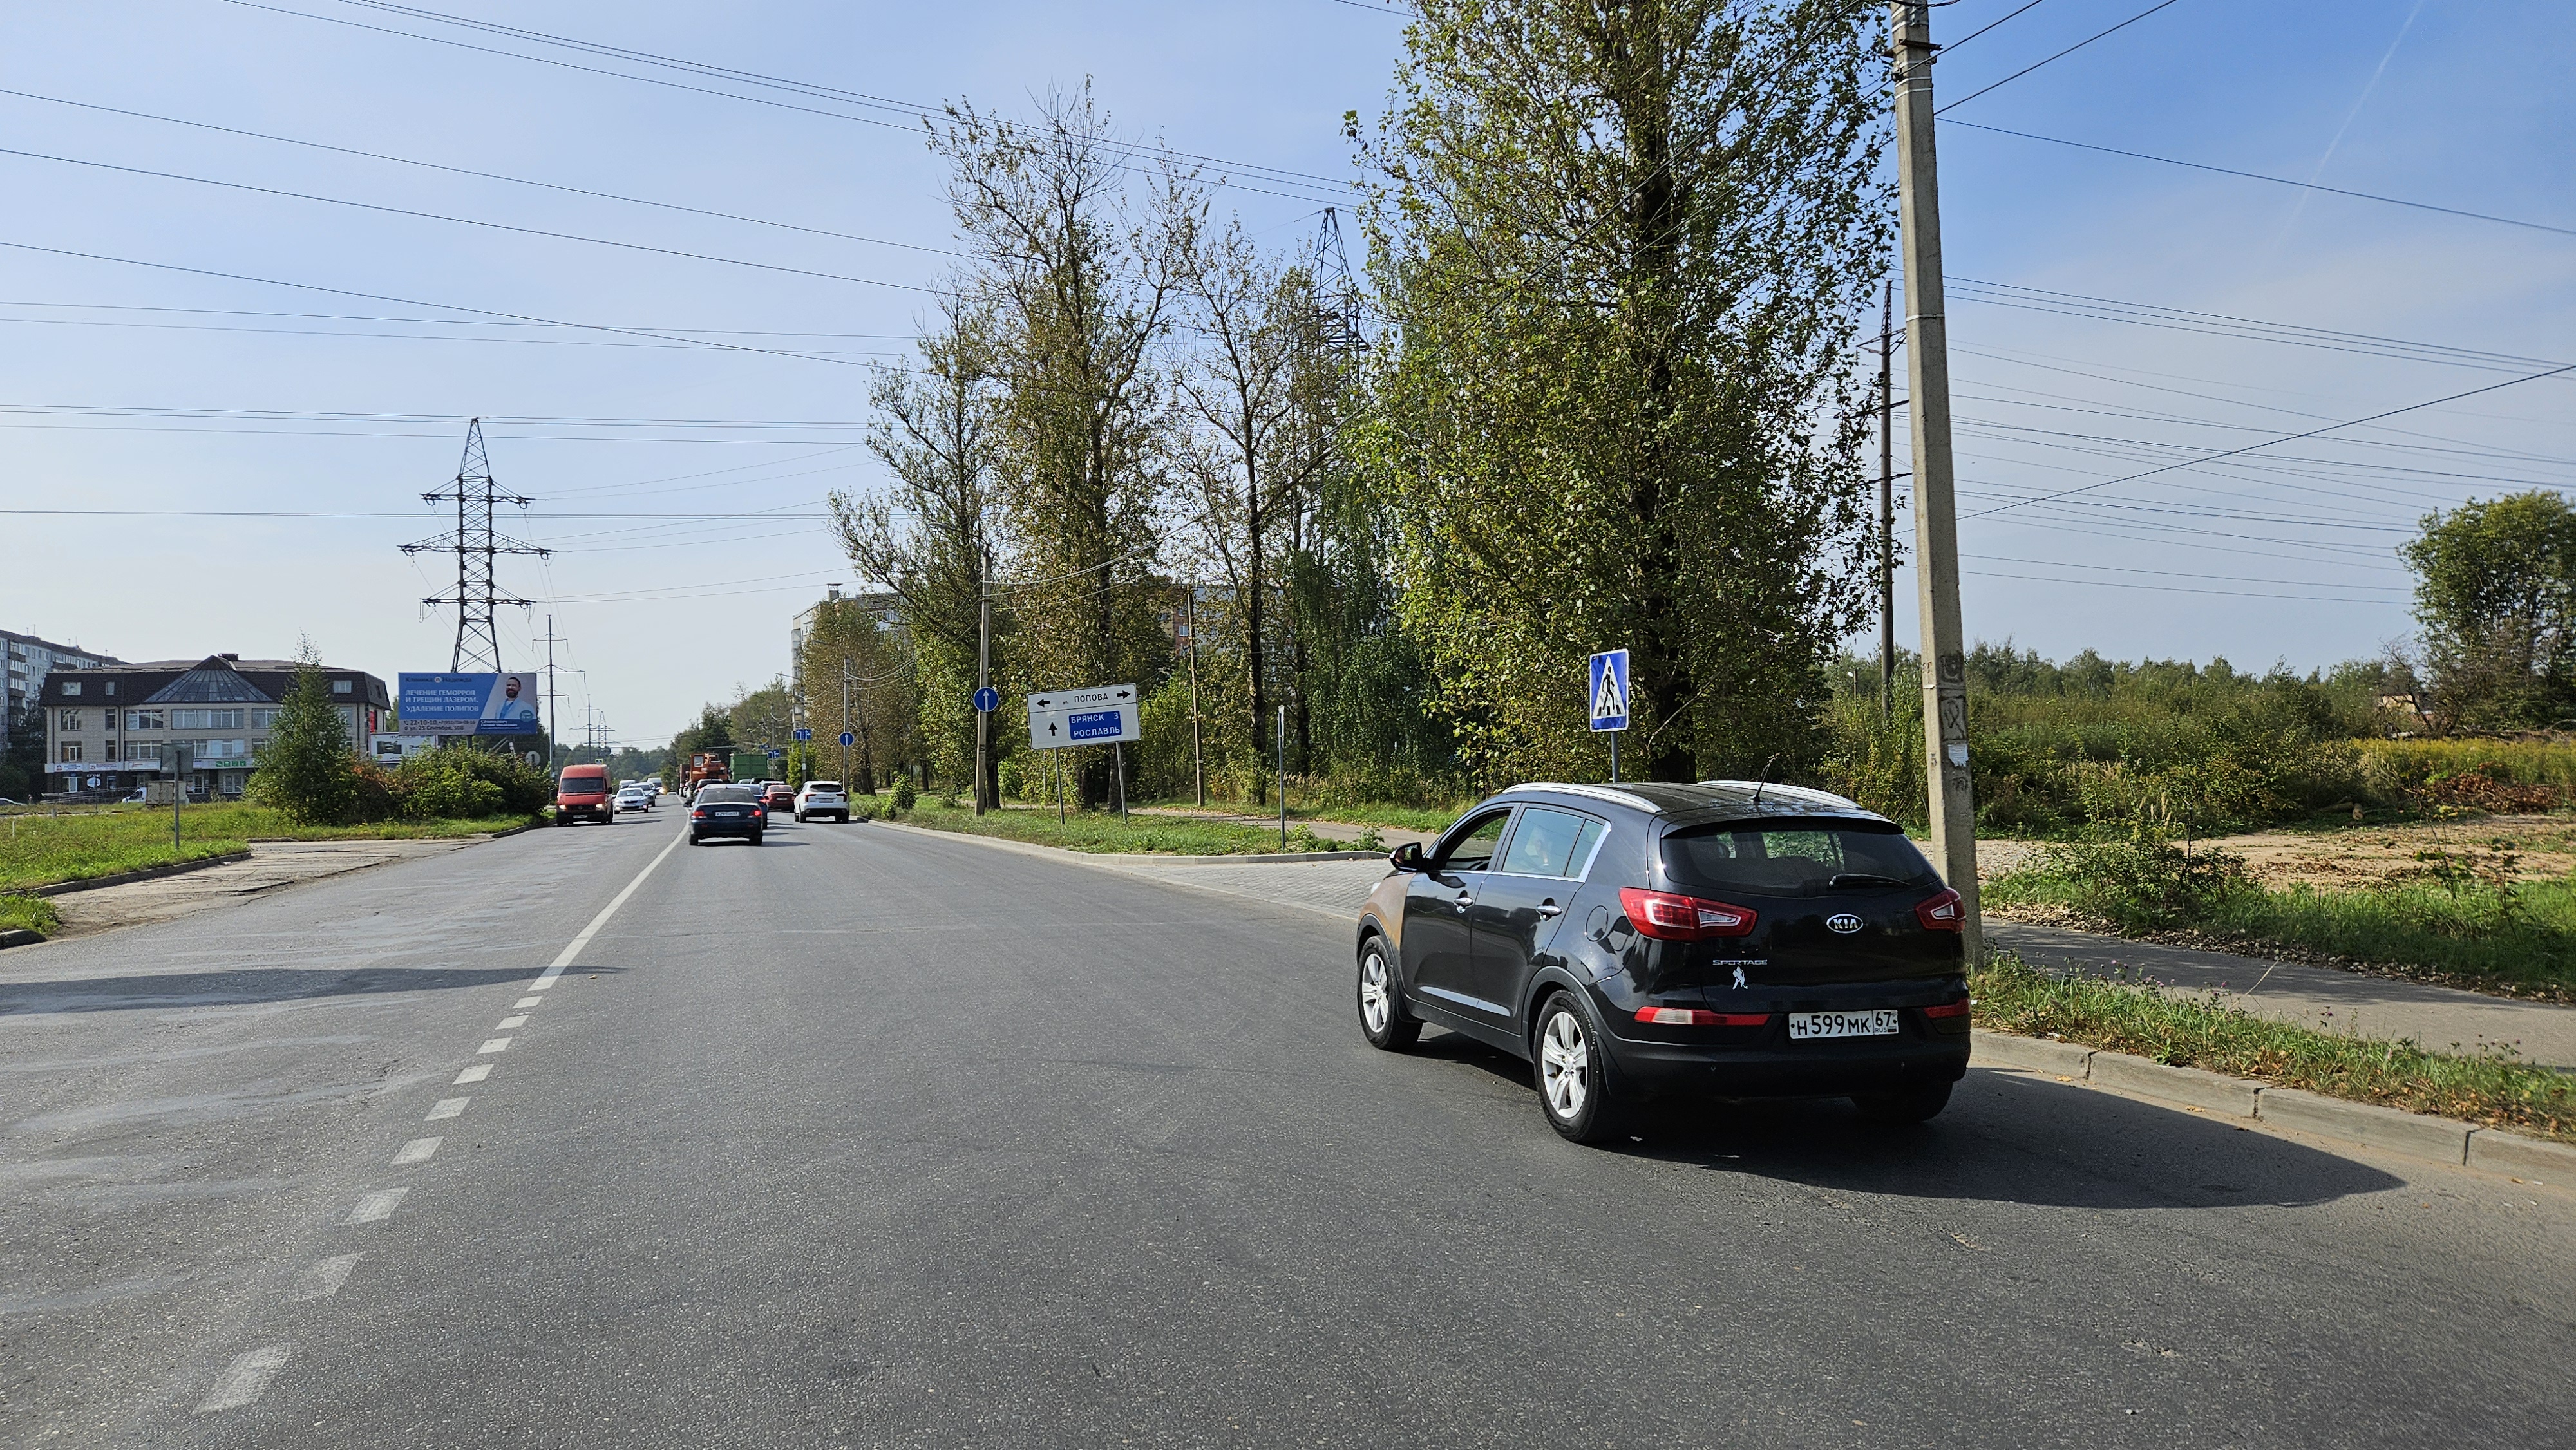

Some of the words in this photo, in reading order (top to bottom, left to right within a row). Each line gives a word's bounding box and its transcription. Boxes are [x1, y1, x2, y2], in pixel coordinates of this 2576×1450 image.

[1074, 693, 1108, 702] ПОПОВА
[1070, 713, 1104, 724] БРЯНСК
[1074, 726, 1120, 738] РОСЛАВЛЬ
[1833, 919, 1859, 929] KIA
[1797, 1014, 1871, 1035] Н599МК
[1875, 1012, 1891, 1026] 67
